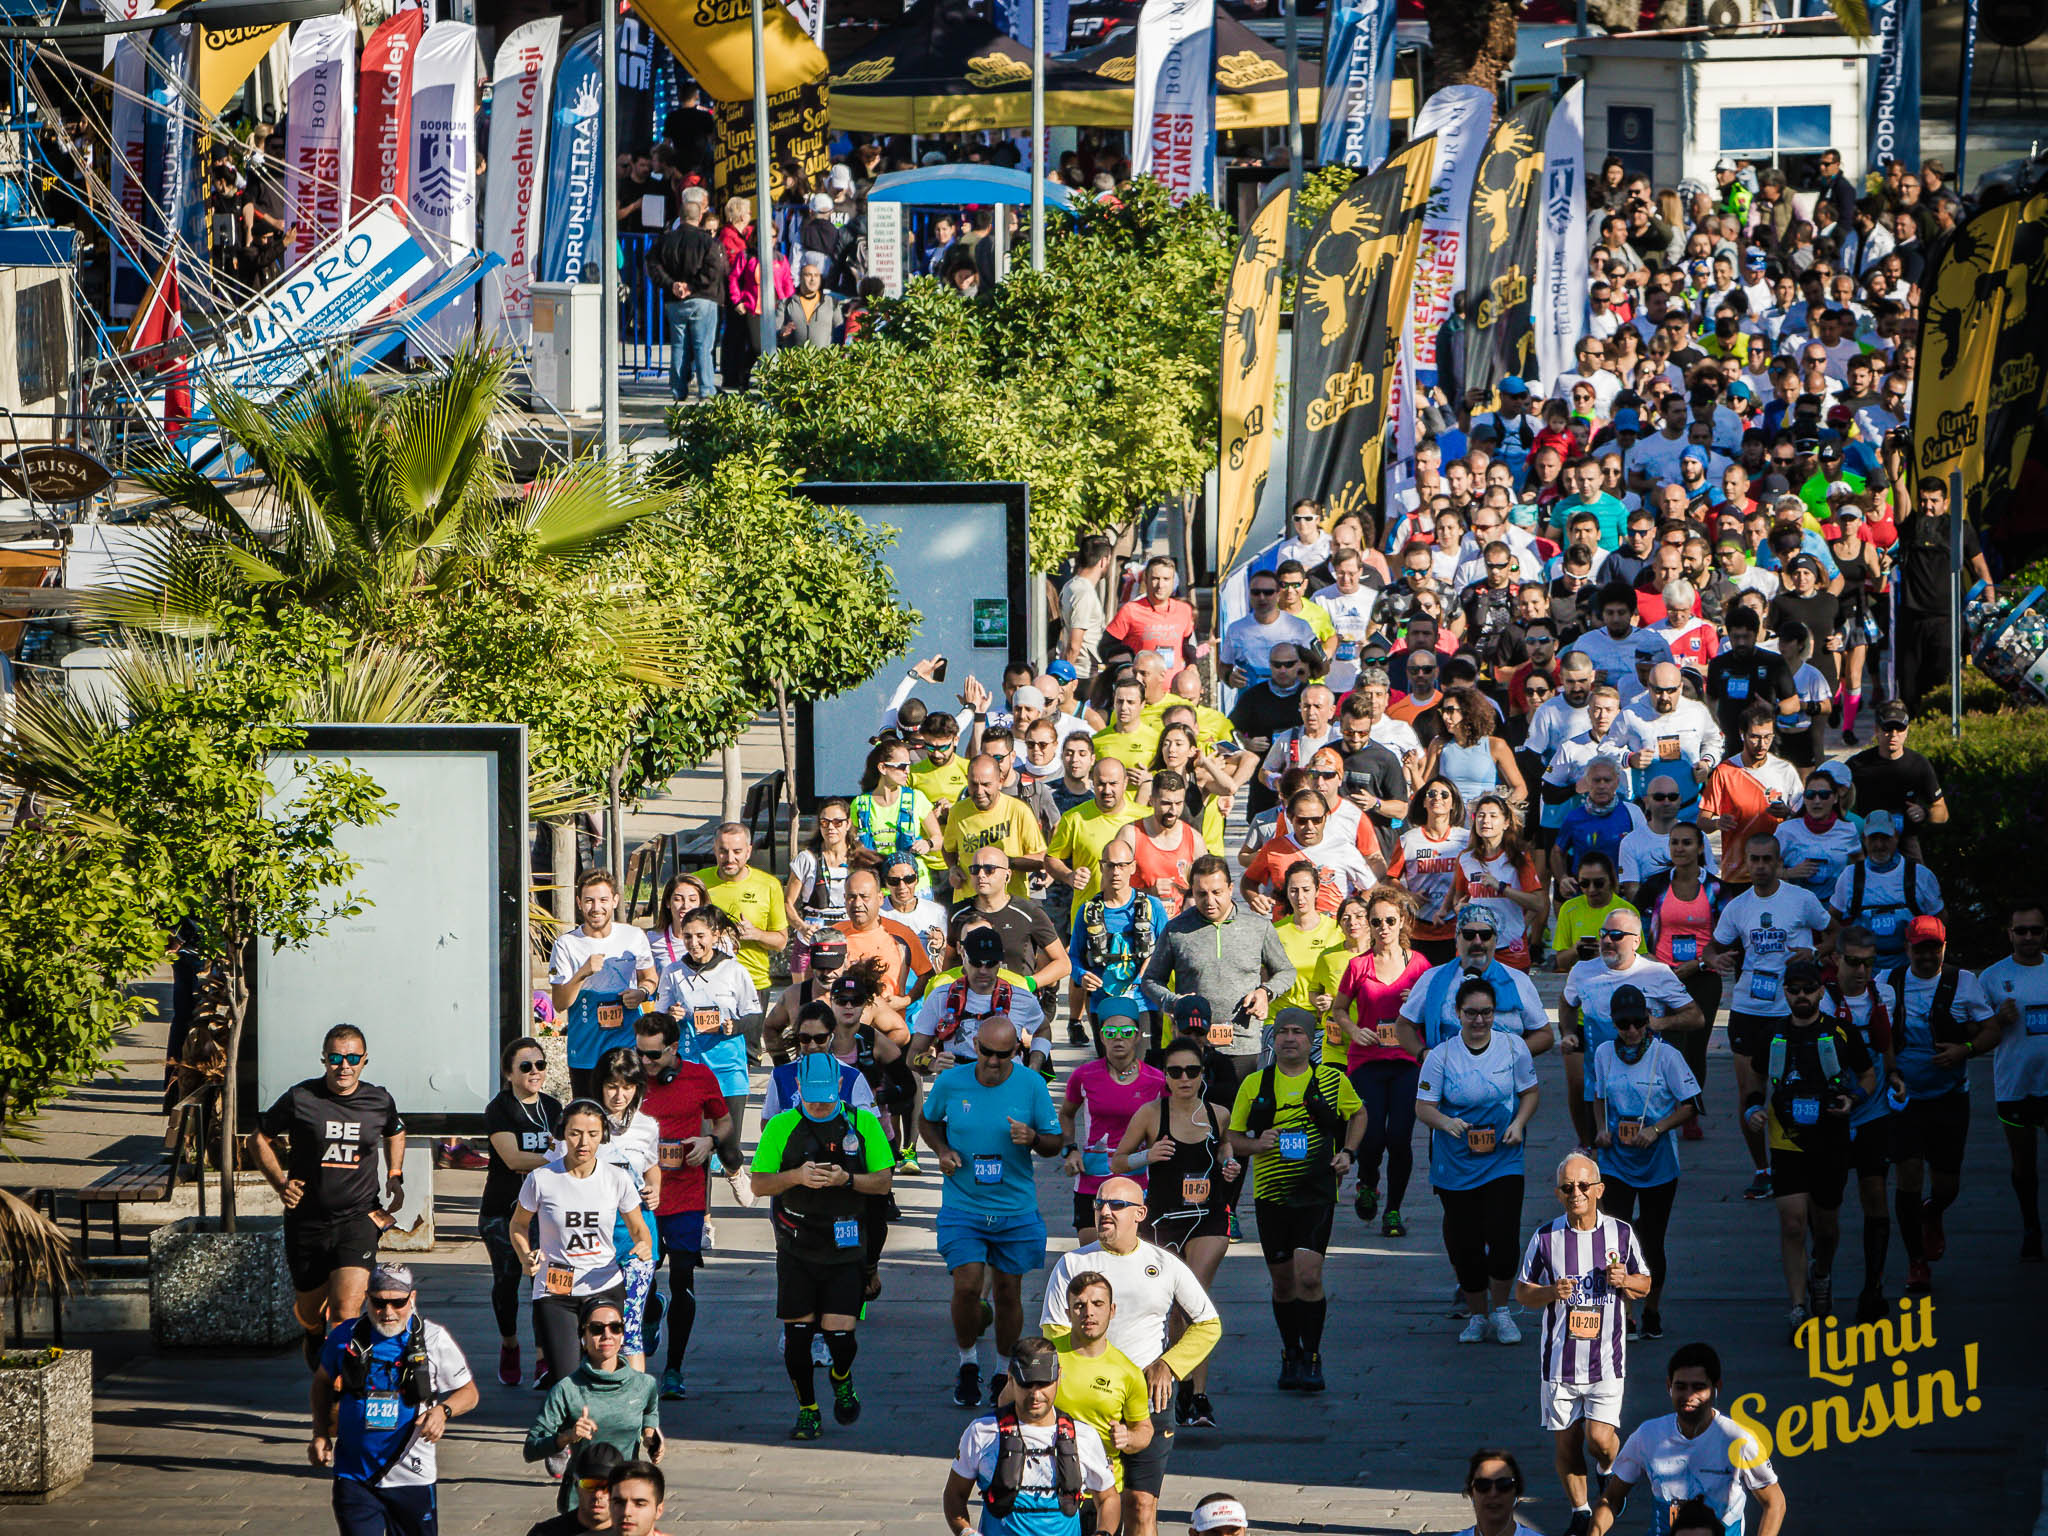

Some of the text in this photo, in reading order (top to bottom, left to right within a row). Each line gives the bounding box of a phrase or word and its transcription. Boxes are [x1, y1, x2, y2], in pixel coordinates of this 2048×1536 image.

[1166, 1, 1187, 95] BODRUM
[382, 33, 410, 105] Koleji
[311, 32, 332, 129] BODRUM
[516, 46, 543, 118] Koleji
[419, 120, 467, 131] BODRUM
[727, 122, 756, 152] Limi
[787, 131, 823, 161] Limit
[328, 293, 350, 312] BOAT
[339, 285, 372, 314] PRIVATE
[979, 820, 1011, 849] RUN
[1417, 858, 1458, 874] RUNNE
[695, 1013, 720, 1025] 10-239
[1208, 1027, 1232, 1039] 10-134
[325, 1120, 361, 1141] BE
[1619, 1124, 1640, 1137] 10-17
[1279, 1137, 1307, 1151] 23-541
[975, 1163, 1002, 1176] 23-367
[565, 1211, 600, 1228] BE
[834, 1224, 859, 1239] 23-519
[1559, 1275, 1618, 1291] TOO
[1570, 1315, 1600, 1330] 10-208
[366, 1402, 399, 1418] 23-324
